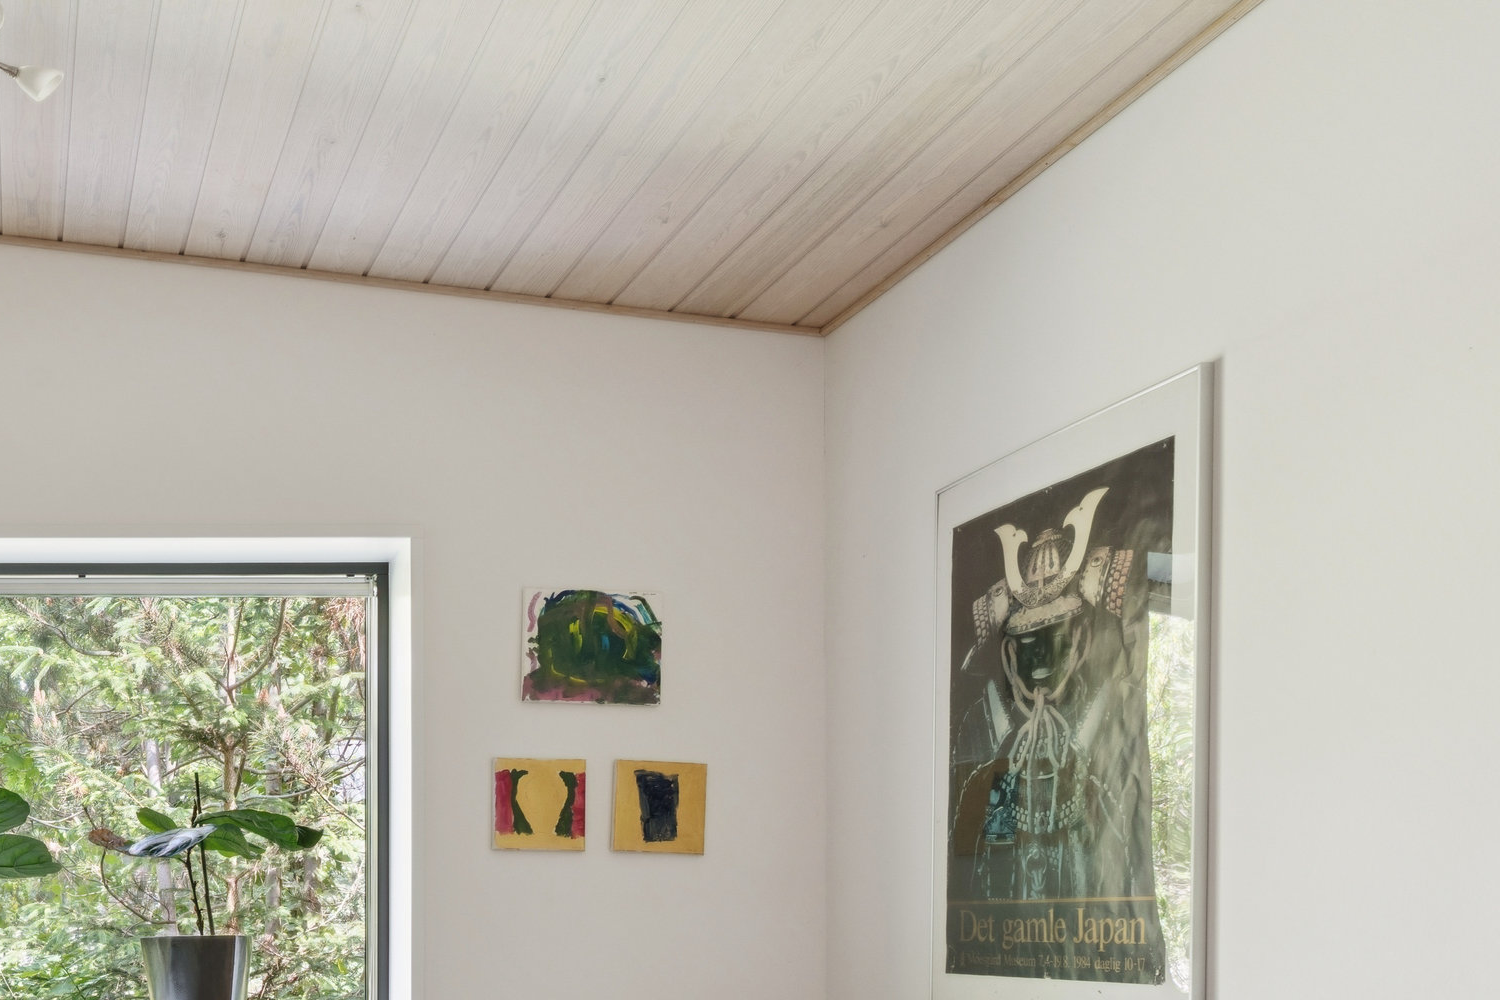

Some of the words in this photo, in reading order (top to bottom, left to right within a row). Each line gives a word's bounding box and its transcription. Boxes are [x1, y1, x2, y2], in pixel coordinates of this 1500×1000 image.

[959, 909, 995, 942] Det
[1002, 908, 1067, 950] gamle
[1073, 907, 1147, 953] Japan
[1073, 955, 1091, 969] 1984
[1094, 956, 1121, 973] daglig
[1124, 957, 1145, 972] 10-17
